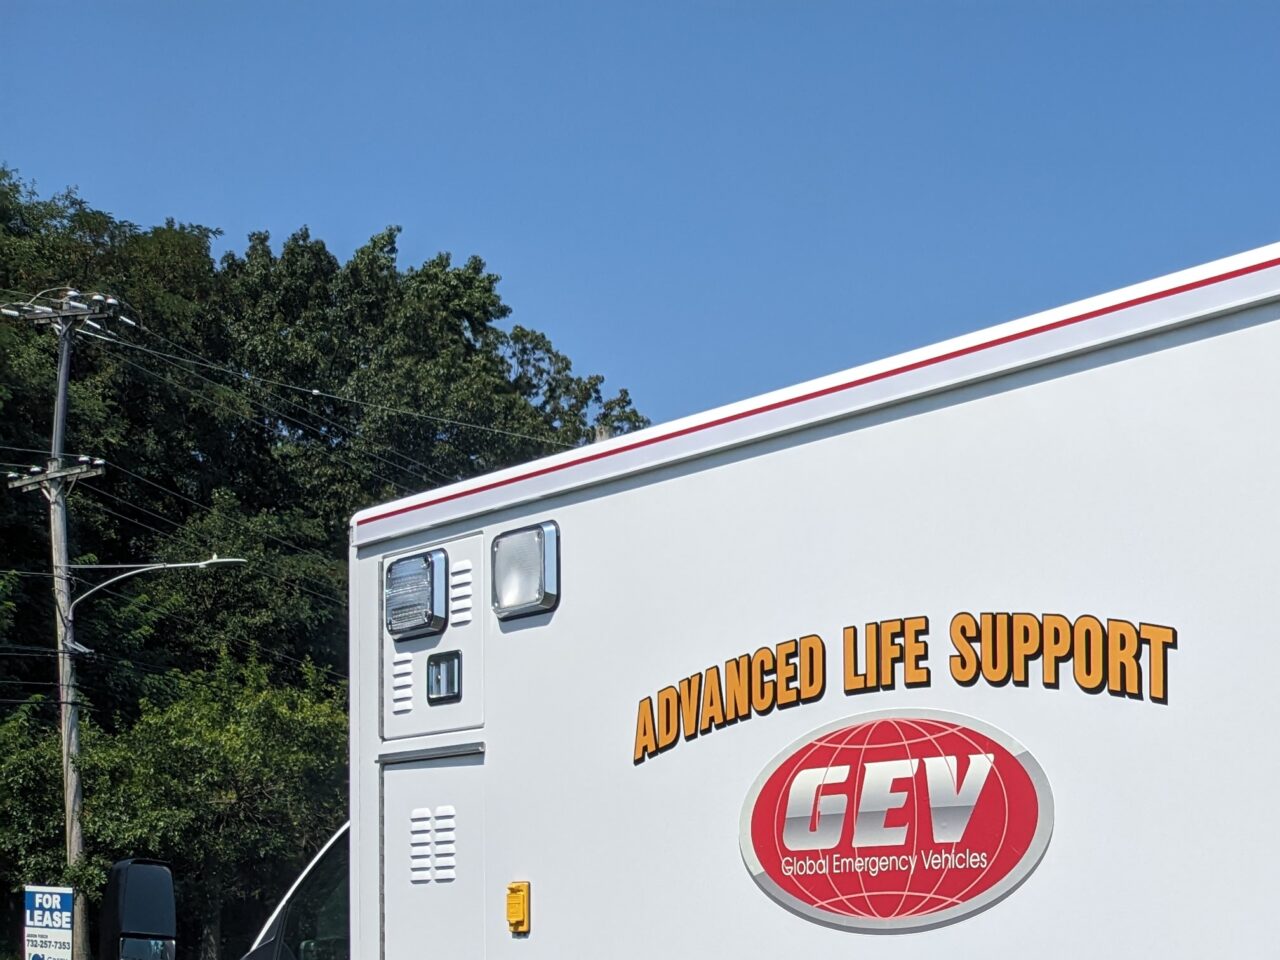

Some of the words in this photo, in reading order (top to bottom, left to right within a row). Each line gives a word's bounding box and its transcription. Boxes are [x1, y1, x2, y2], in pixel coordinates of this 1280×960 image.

[633, 634, 826, 765] ADVANCED
[843, 616, 931, 696] LIFE
[950, 612, 1178, 705] SUPPORT
[783, 753, 995, 851] GEV
[782, 855, 829, 876] Global
[834, 854, 917, 876] Emergency
[922, 849, 988, 870] Vehicles
[35, 893, 61, 909] FOR
[26, 910, 71, 929] LEASE
[27, 939, 70, 950] 732-257-7353
